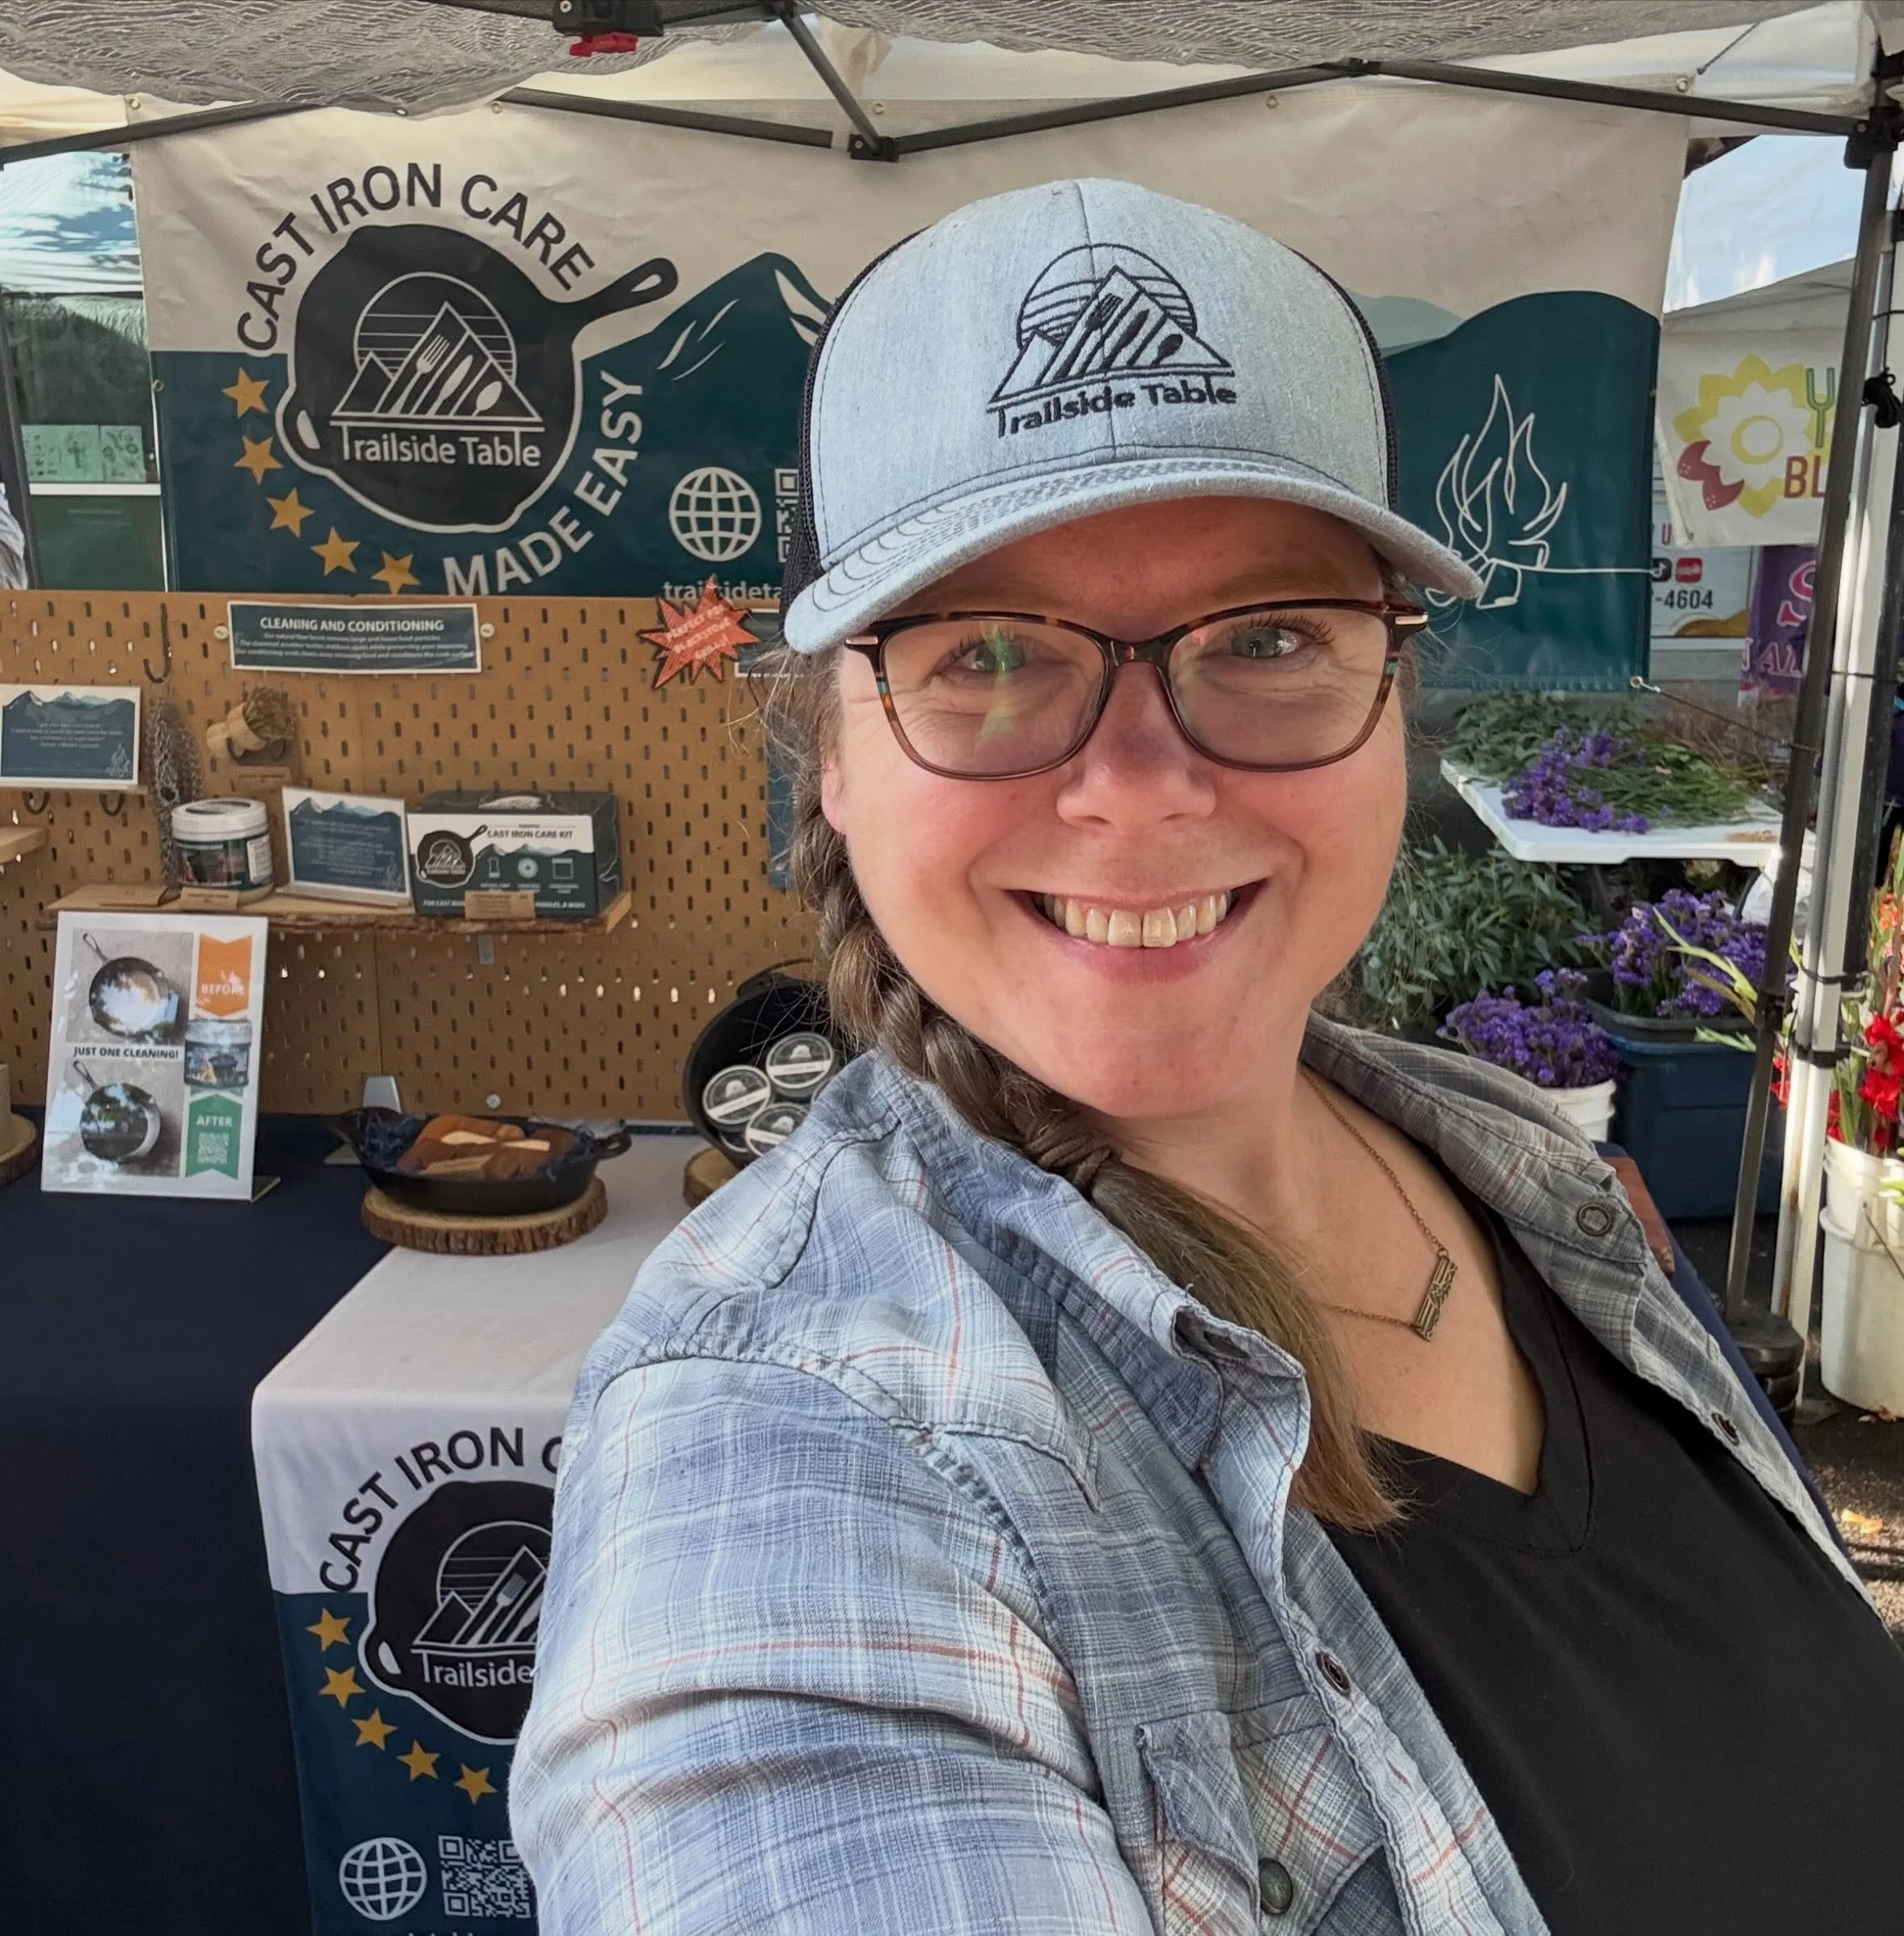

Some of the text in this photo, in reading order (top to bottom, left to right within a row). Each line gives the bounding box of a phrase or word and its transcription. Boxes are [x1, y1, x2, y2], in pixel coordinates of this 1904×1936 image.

[237, 163, 594, 351] CAST IRON CARE
[998, 377, 1237, 438] Trailside Table
[343, 427, 541, 468] Trailside Table
[442, 371, 643, 597] MADE EASY
[1651, 589, 1714, 609] -4604
[260, 617, 444, 633] CLEANING AND CONDITIONING
[487, 830, 574, 839] CAST IRON CARE KIT
[74, 1046, 179, 1060] JUST ONE CLEANING!
[196, 1115, 234, 1128] AFTER
[319, 1472, 399, 1592] CAST
[395, 1427, 524, 1491] IRON
[423, 1653, 533, 1688] Trailside
